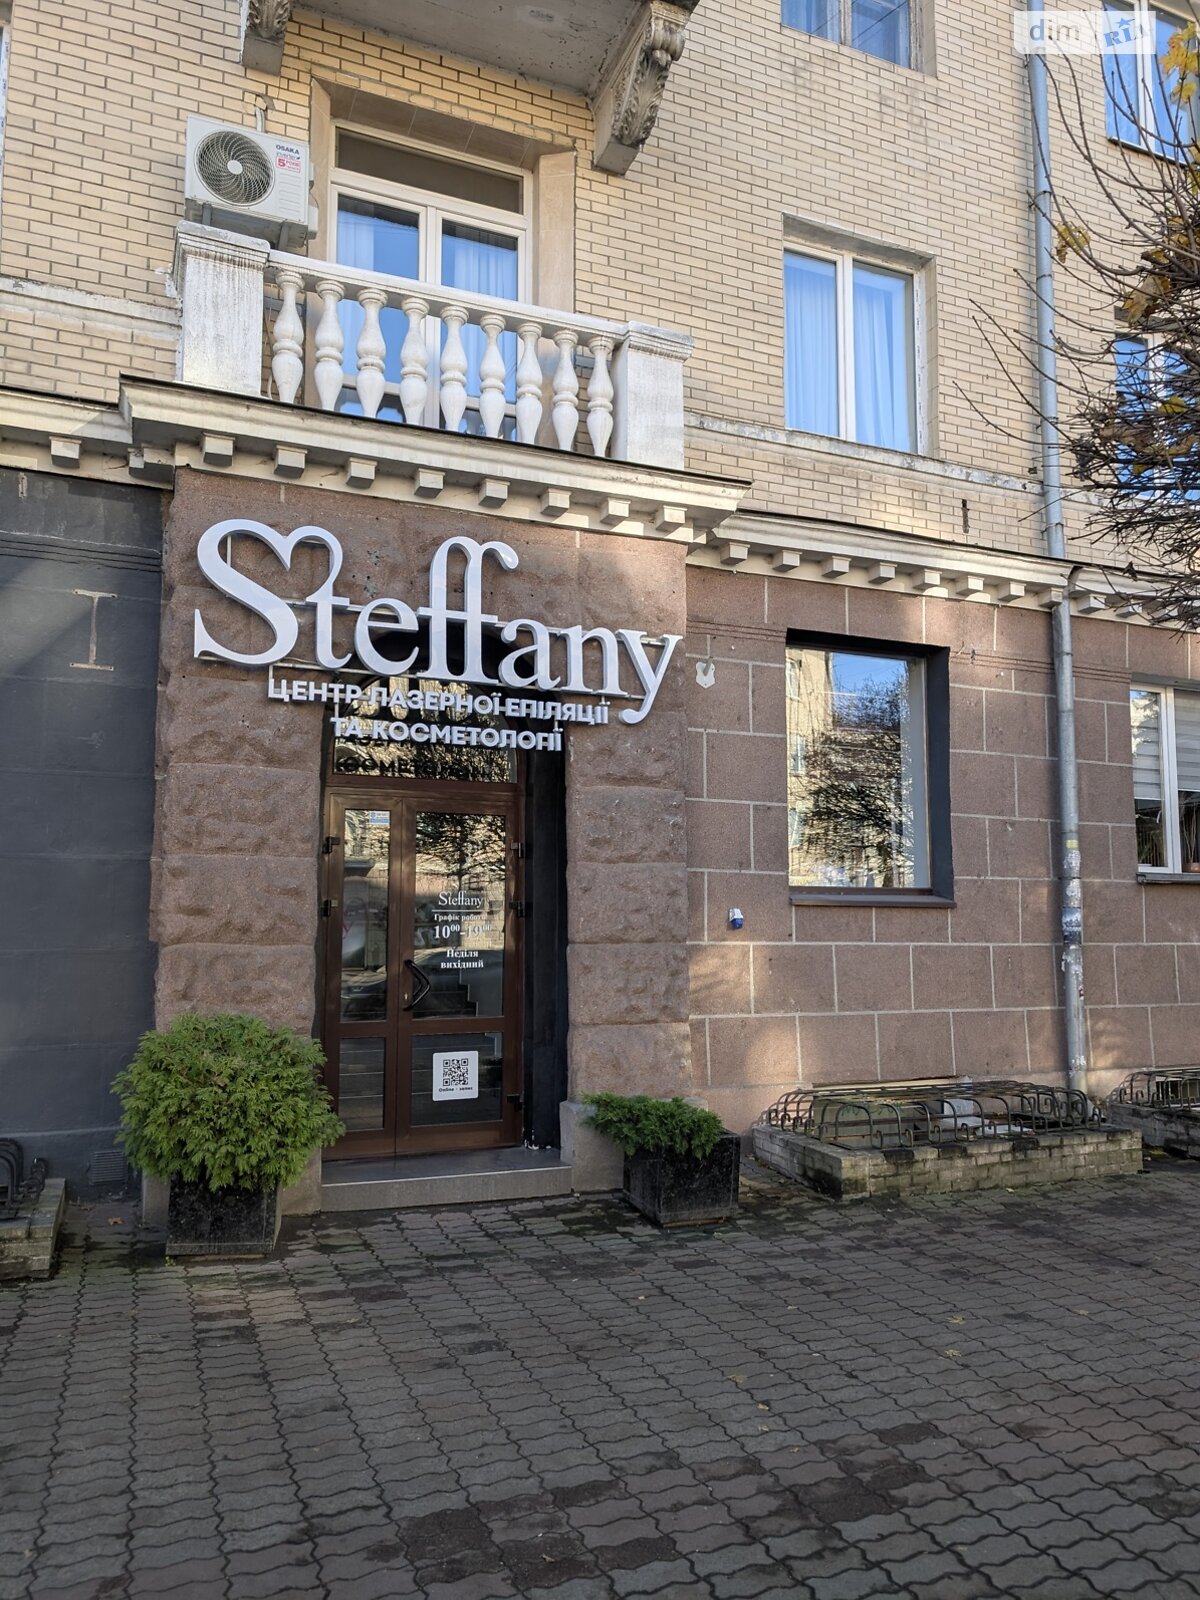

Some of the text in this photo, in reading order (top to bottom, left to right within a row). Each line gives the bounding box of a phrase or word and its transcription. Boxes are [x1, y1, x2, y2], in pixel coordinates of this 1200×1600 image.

[276, 144, 299, 155] OSAKA
[278, 158, 286, 167] 5
[193, 518, 684, 725] Steffany
[268, 678, 611, 726] ЦЕНТР ЛАЗЕРНОЇ ЕПІЛЯЦІЇ
[330, 717, 564, 752] ТА КОСМЕТОЛОГІЇ
[438, 891, 484, 908] Steffany
[434, 914, 460, 922] Графік
[447, 949, 478, 957] Неділя
[440, 960, 484, 969] вихідний
